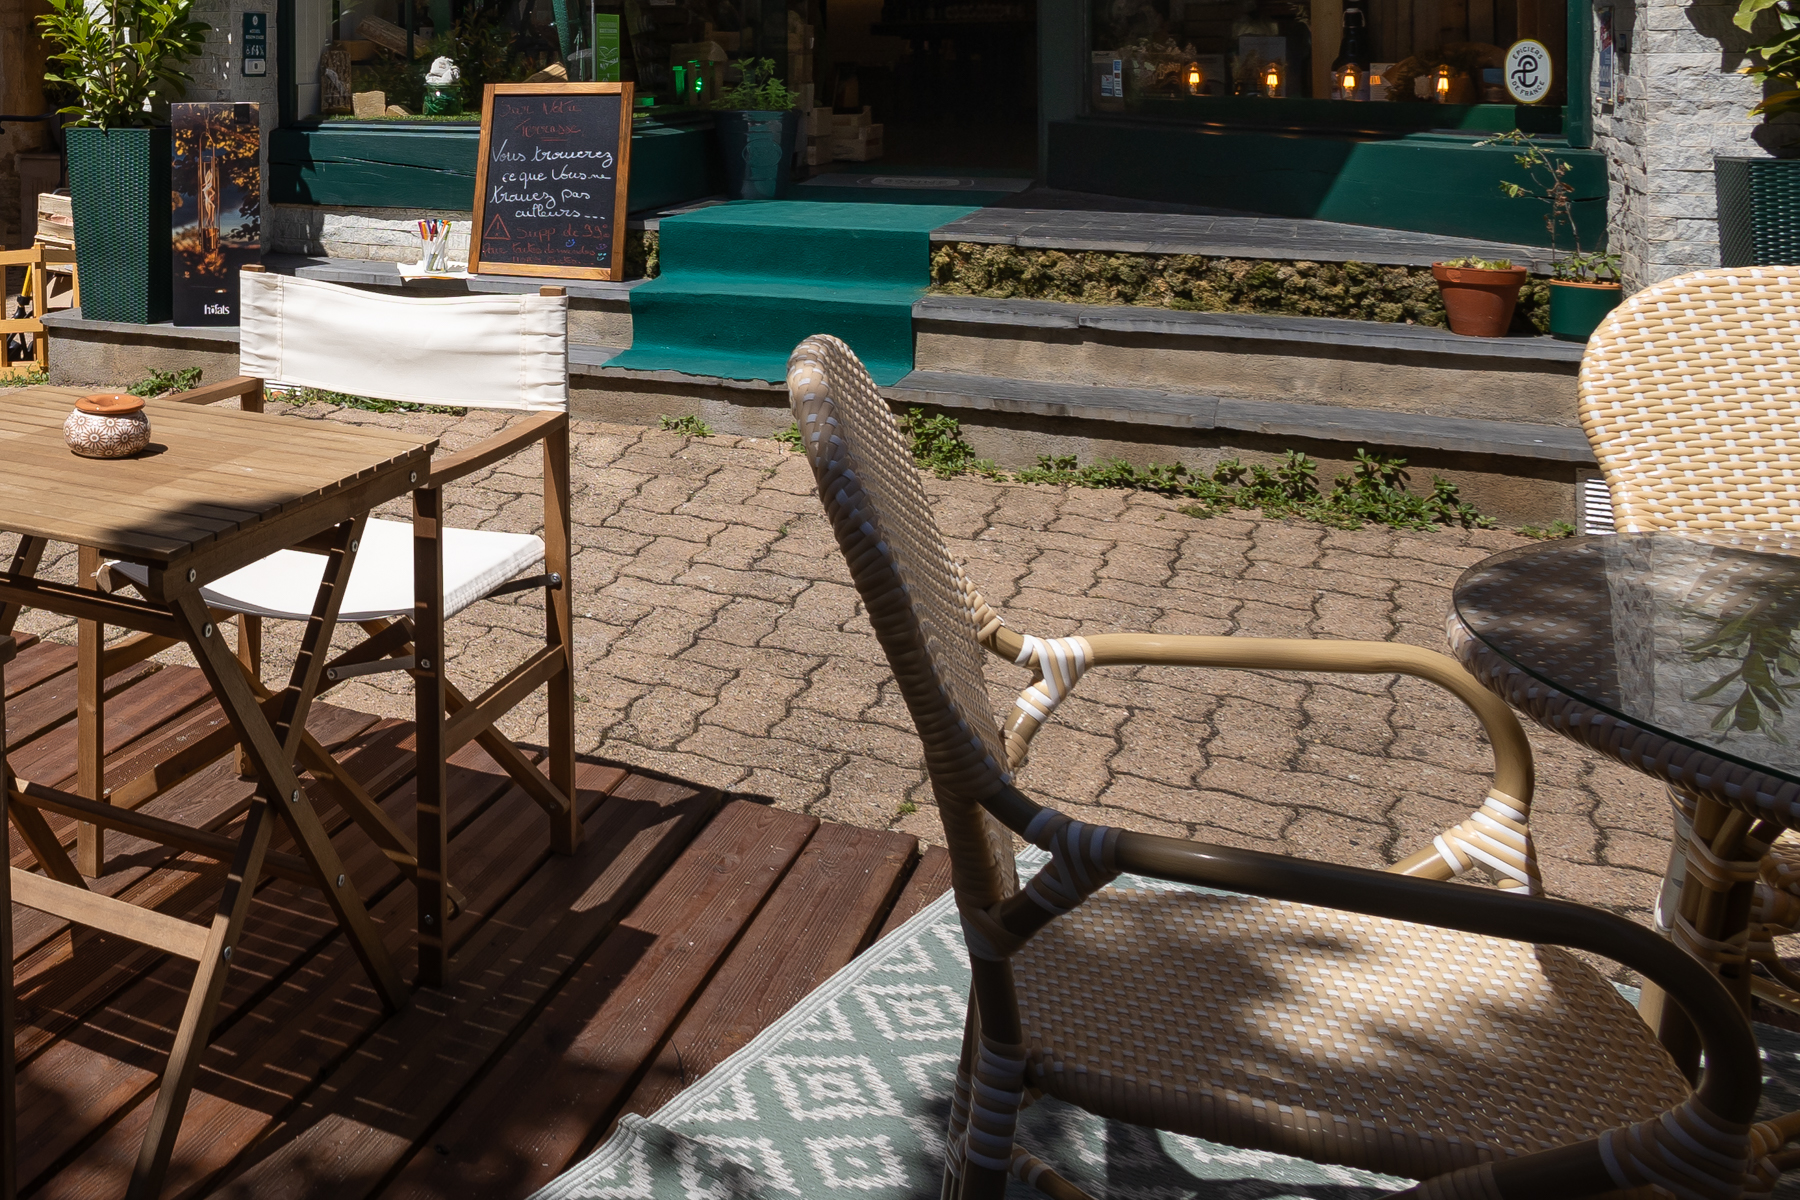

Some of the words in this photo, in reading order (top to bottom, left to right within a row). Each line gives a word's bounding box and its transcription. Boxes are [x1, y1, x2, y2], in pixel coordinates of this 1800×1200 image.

[1511, 80, 1520, 91] DE
[1519, 80, 1545, 96] FRANCE
[491, 139, 527, 163] Vous
[530, 145, 614, 168] trouverez
[502, 172, 517, 183] ce
[518, 172, 547, 189] que
[552, 164, 587, 181] Vous
[561, 189, 591, 202] pas
[204, 303, 230, 315] höfats
